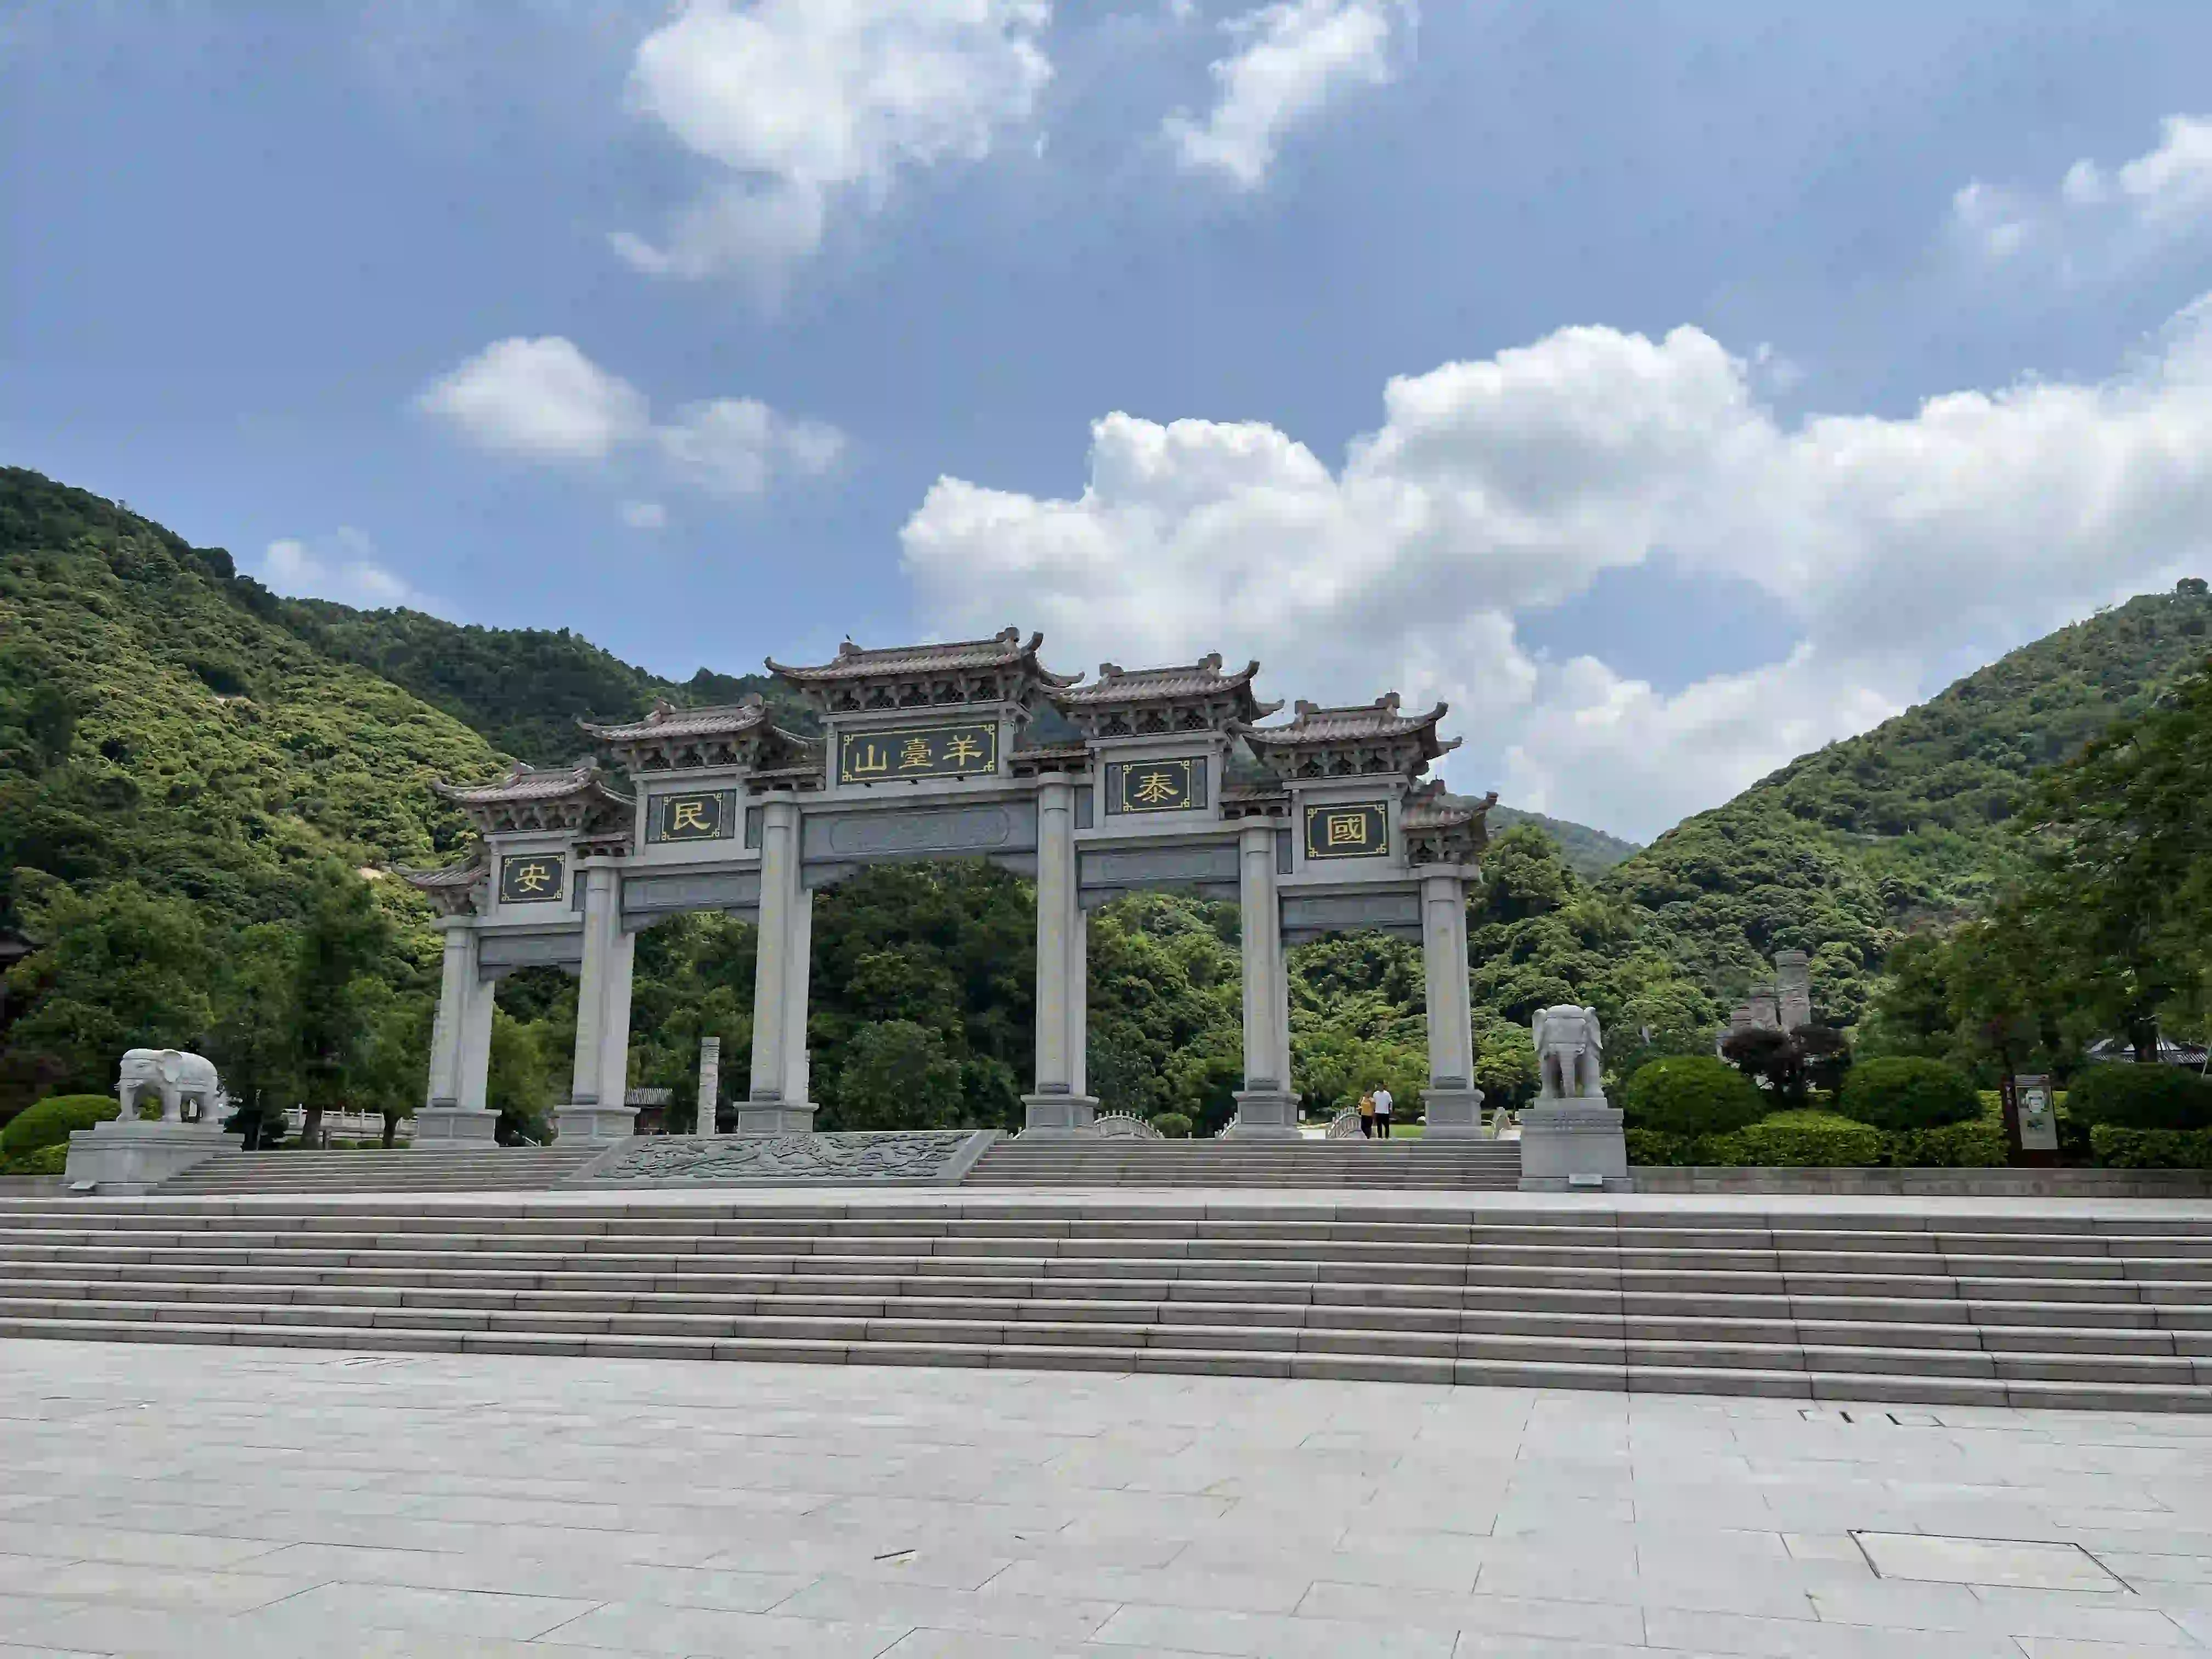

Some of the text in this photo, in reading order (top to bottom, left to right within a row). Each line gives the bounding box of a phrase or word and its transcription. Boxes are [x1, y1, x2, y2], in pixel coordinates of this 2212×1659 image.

[1133, 772, 1179, 803] 泰
[673, 801, 711, 830] 民
[1327, 813, 1367, 847] 國
[514, 864, 550, 892] 安
